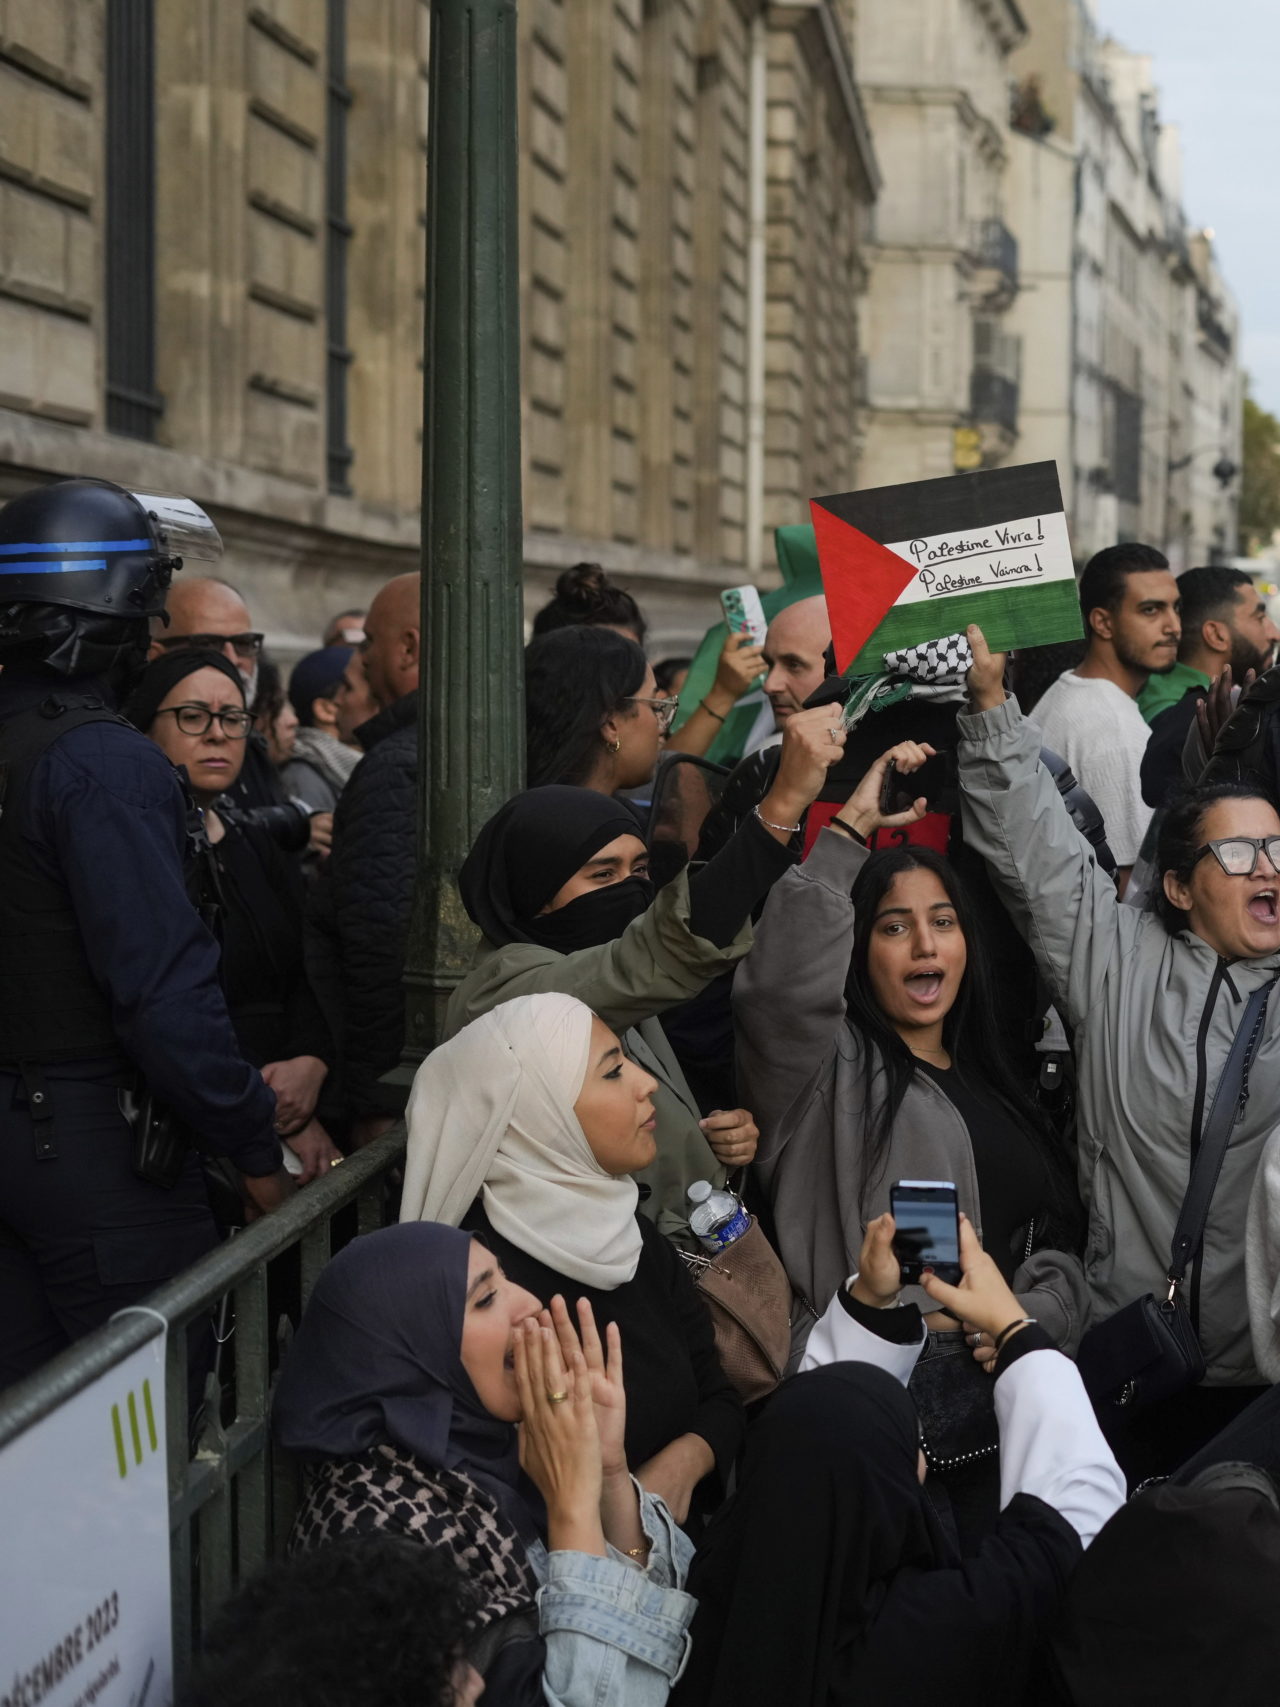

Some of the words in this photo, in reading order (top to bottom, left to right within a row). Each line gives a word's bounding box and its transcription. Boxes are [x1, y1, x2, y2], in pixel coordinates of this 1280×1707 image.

[909, 539, 992, 564] Palestine
[919, 569, 982, 593] Palestine
[86, 1589, 119, 1653] 2023
